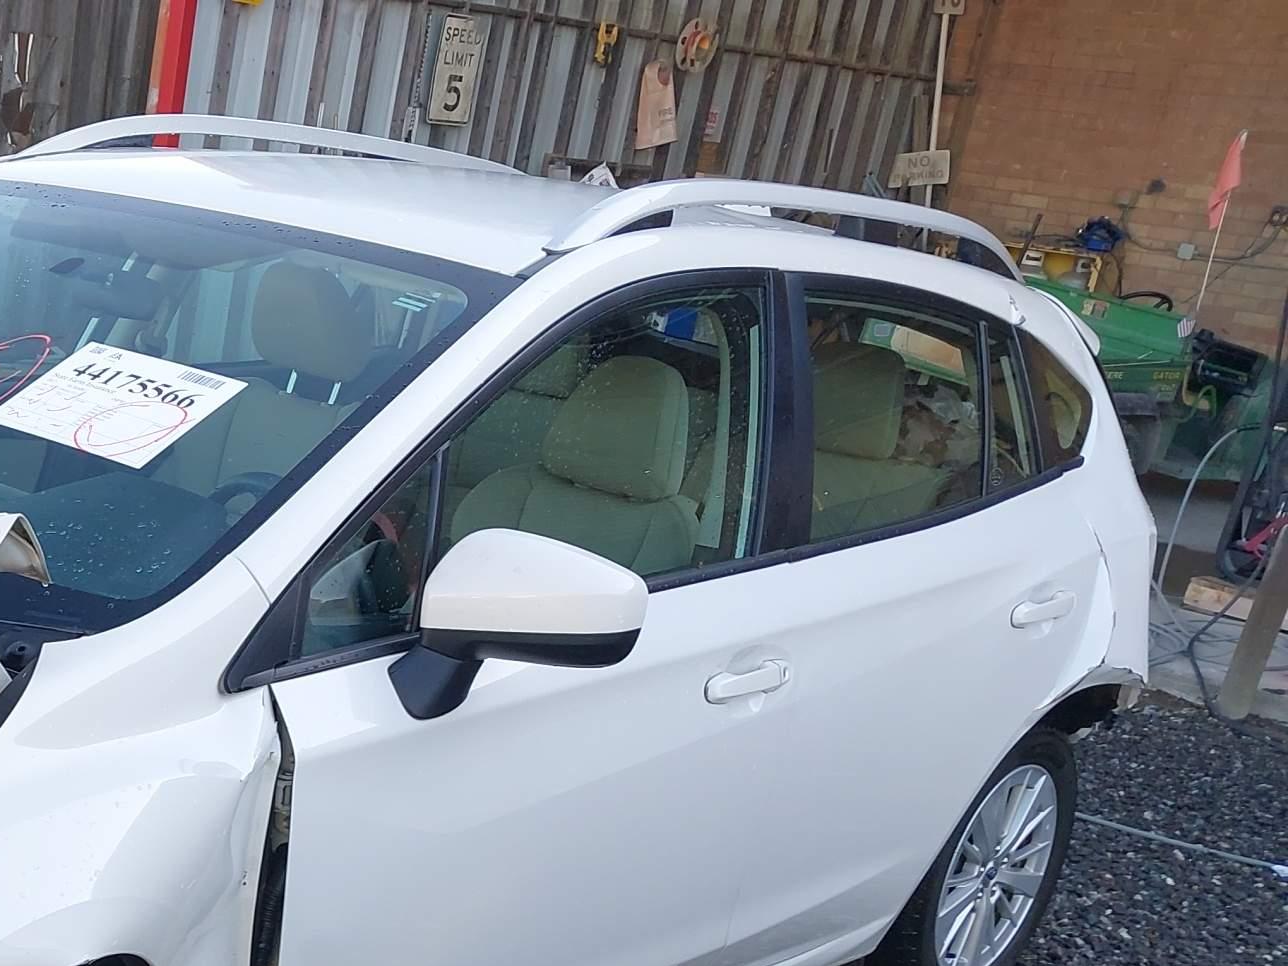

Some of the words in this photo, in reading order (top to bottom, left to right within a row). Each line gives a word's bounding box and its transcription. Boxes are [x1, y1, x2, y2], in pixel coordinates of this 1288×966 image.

[444, 26, 484, 46] SPEED
[443, 50, 475, 68] LIMIT
[443, 74, 464, 112] 5
[907, 155, 930, 169] NO
[73, 362, 206, 409] 44175566
